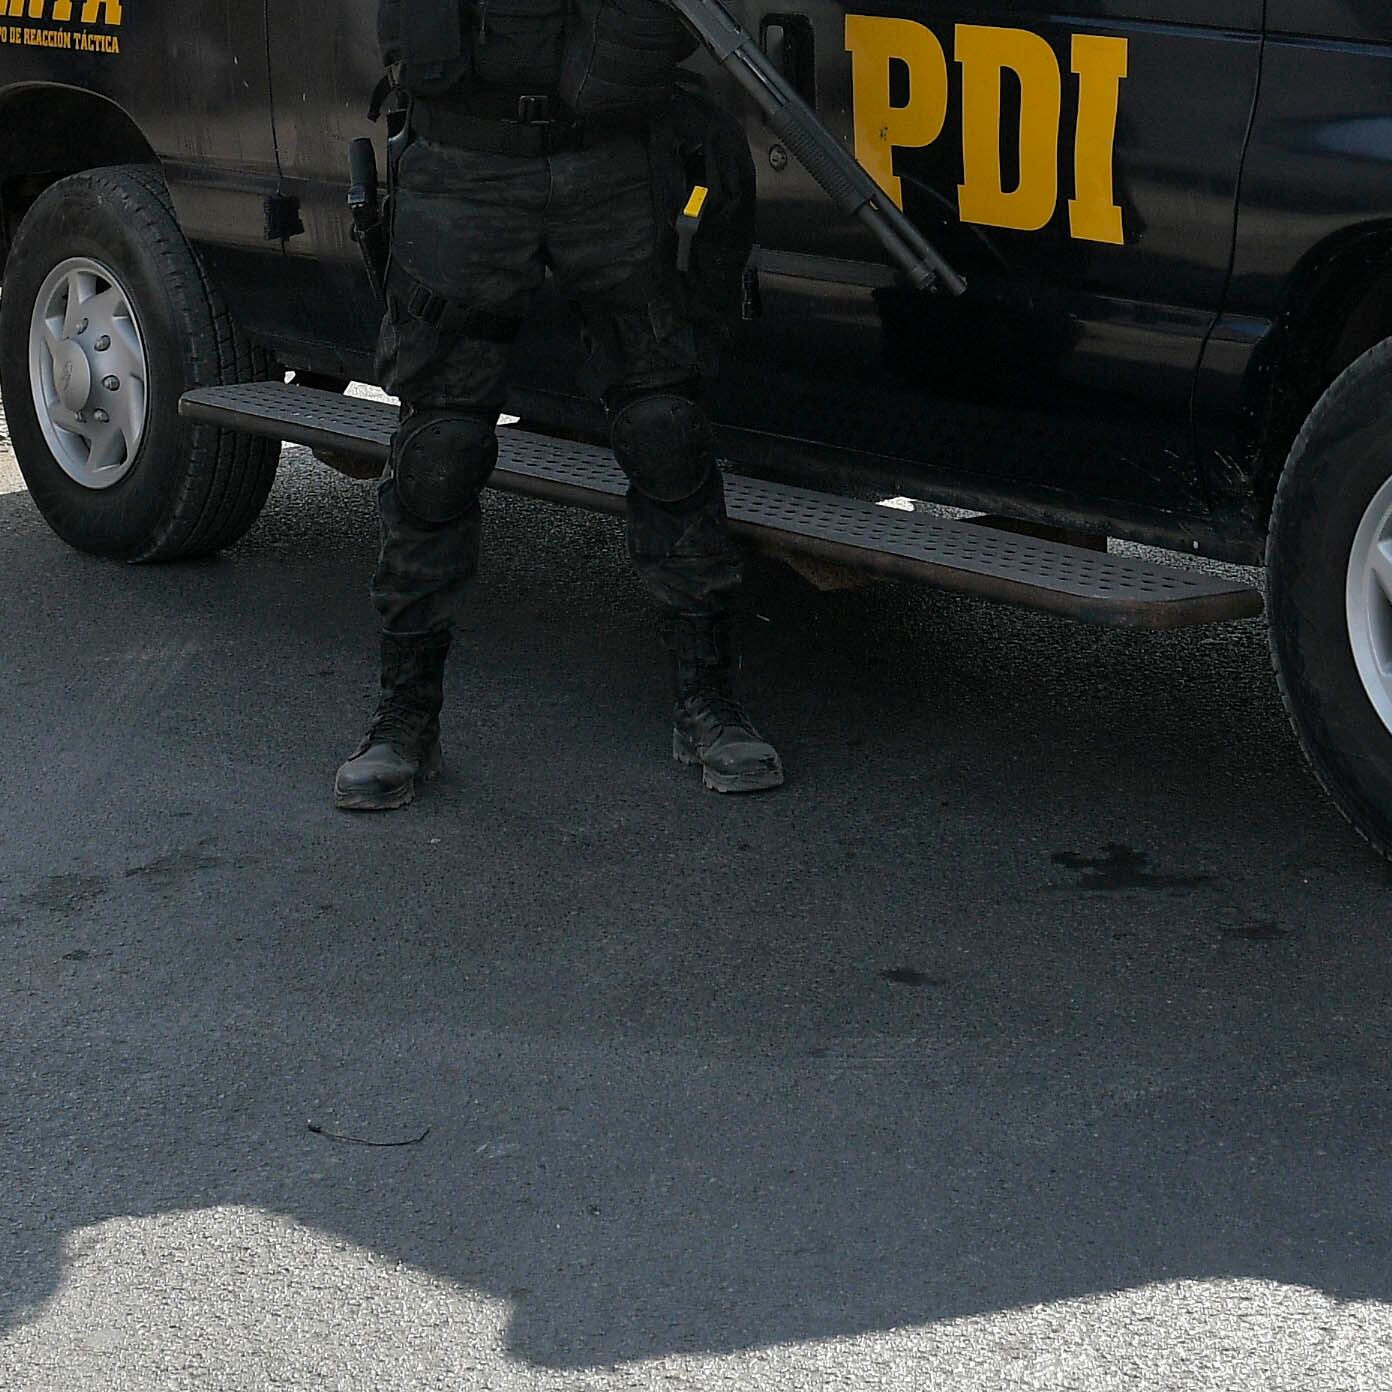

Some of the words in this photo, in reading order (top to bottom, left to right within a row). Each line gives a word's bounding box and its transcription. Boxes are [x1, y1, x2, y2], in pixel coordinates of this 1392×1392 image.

[9, 26, 22, 44] DE
[23, 27, 71, 48] REACCIÓN
[73, 29, 120, 54] TÁCTICA
[844, 13, 1128, 246] PDI
